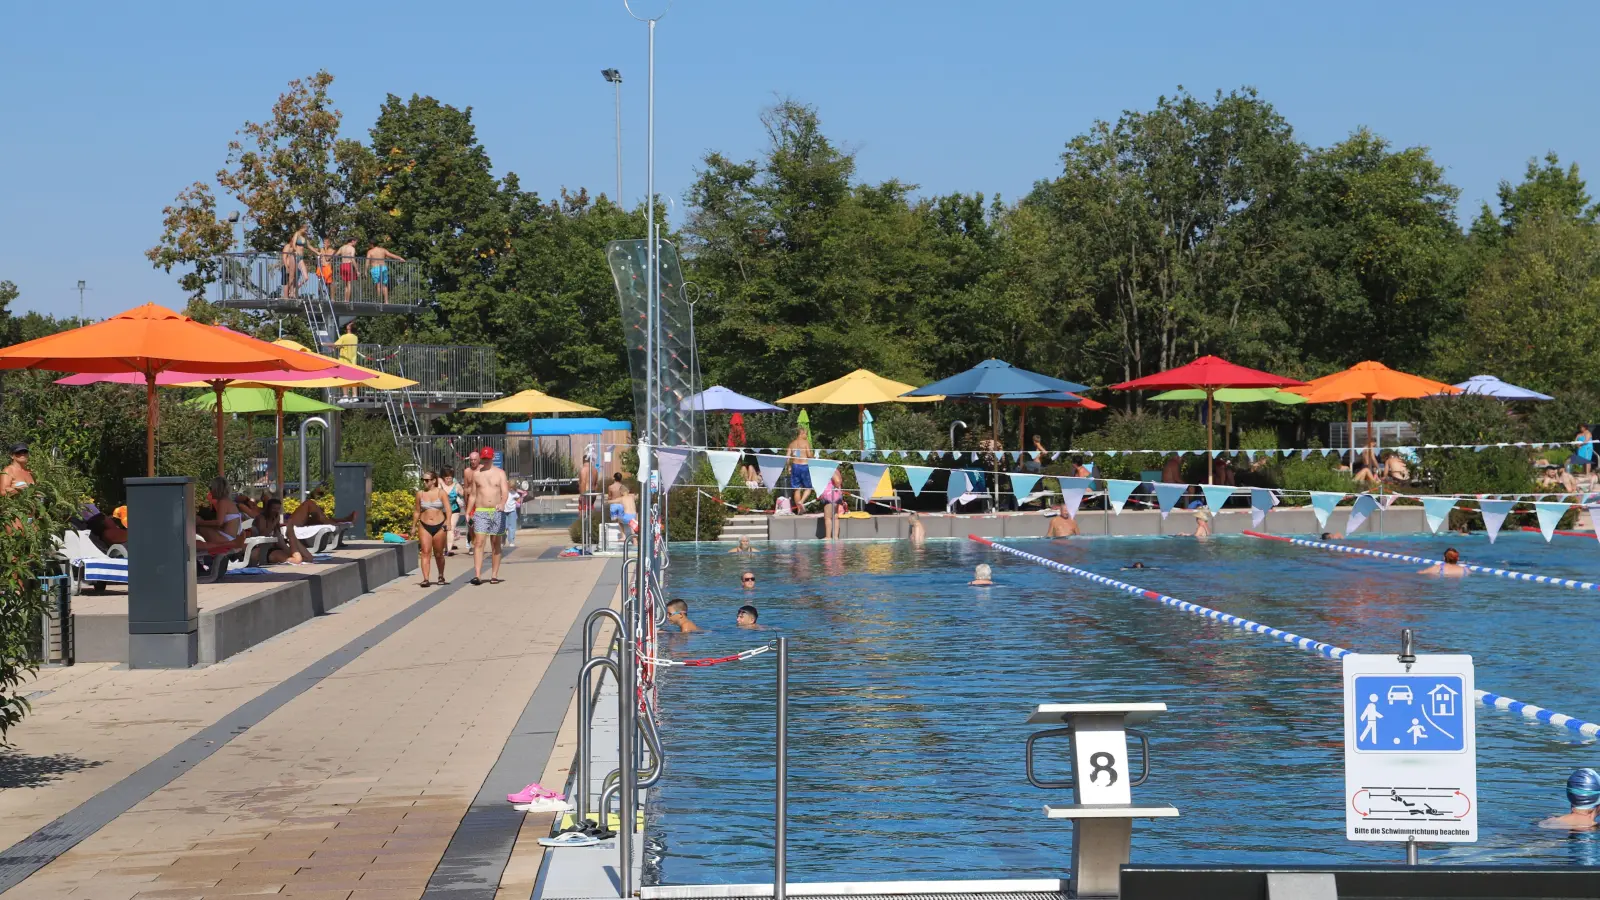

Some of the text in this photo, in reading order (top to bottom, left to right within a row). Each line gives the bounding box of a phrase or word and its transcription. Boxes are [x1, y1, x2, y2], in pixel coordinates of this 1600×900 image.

[1090, 751, 1118, 787] 8
[1370, 827, 1380, 835] die
[1381, 828, 1439, 836] Schwimmrichtung
[1439, 828, 1470, 836] beachten
